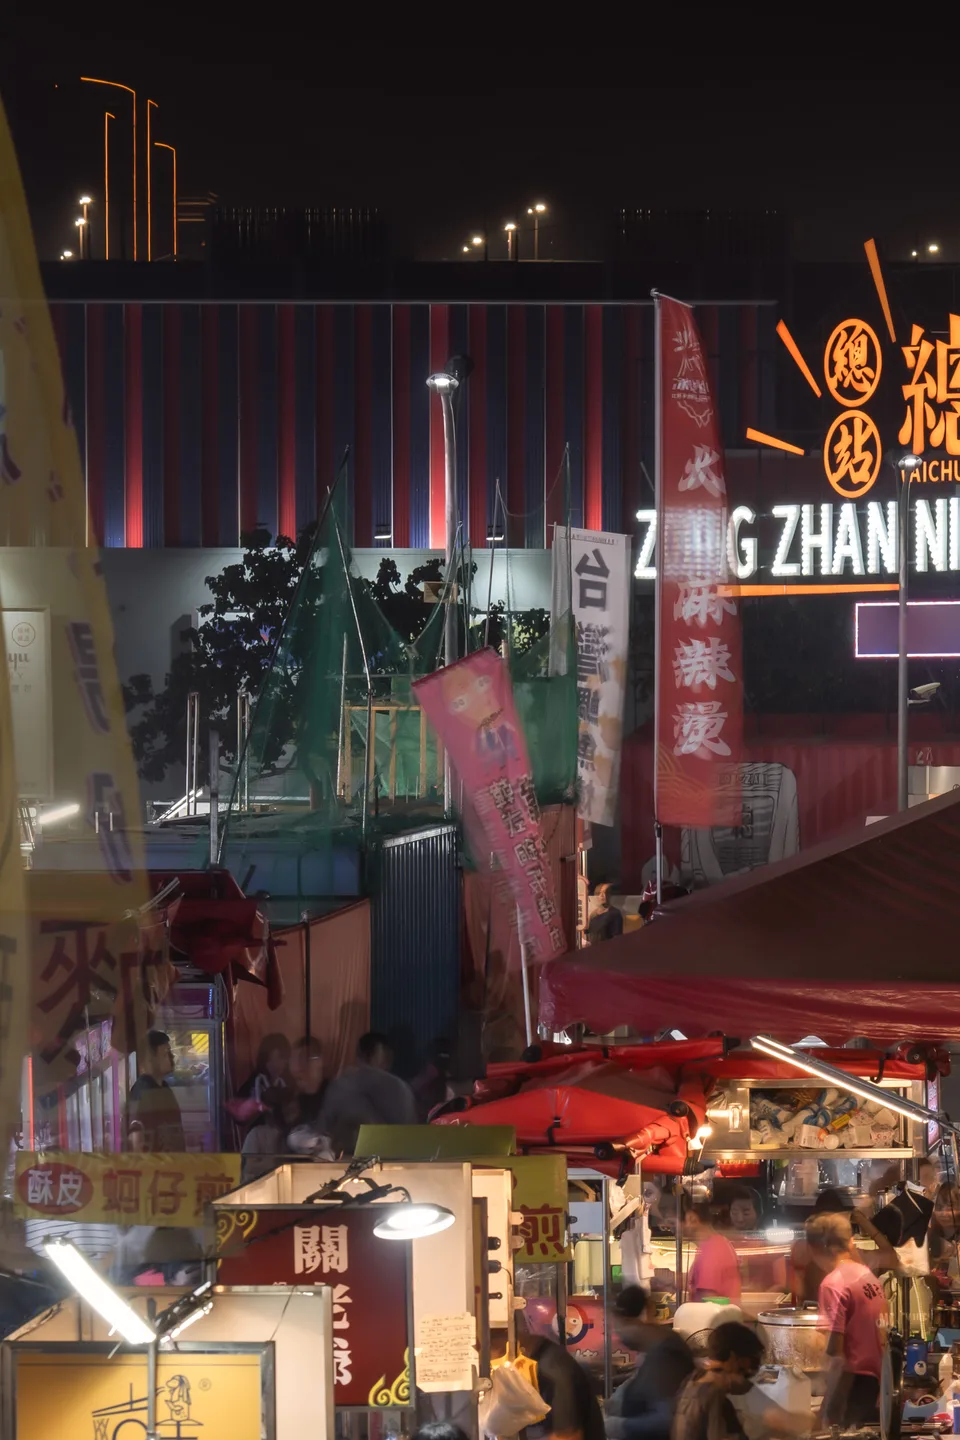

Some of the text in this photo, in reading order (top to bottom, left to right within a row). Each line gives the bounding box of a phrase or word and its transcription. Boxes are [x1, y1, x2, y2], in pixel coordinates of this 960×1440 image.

[634, 505, 758, 580] ZG
[771, 501, 899, 576] ZHAN
[27, 1169, 83, 1207] 酥皮
